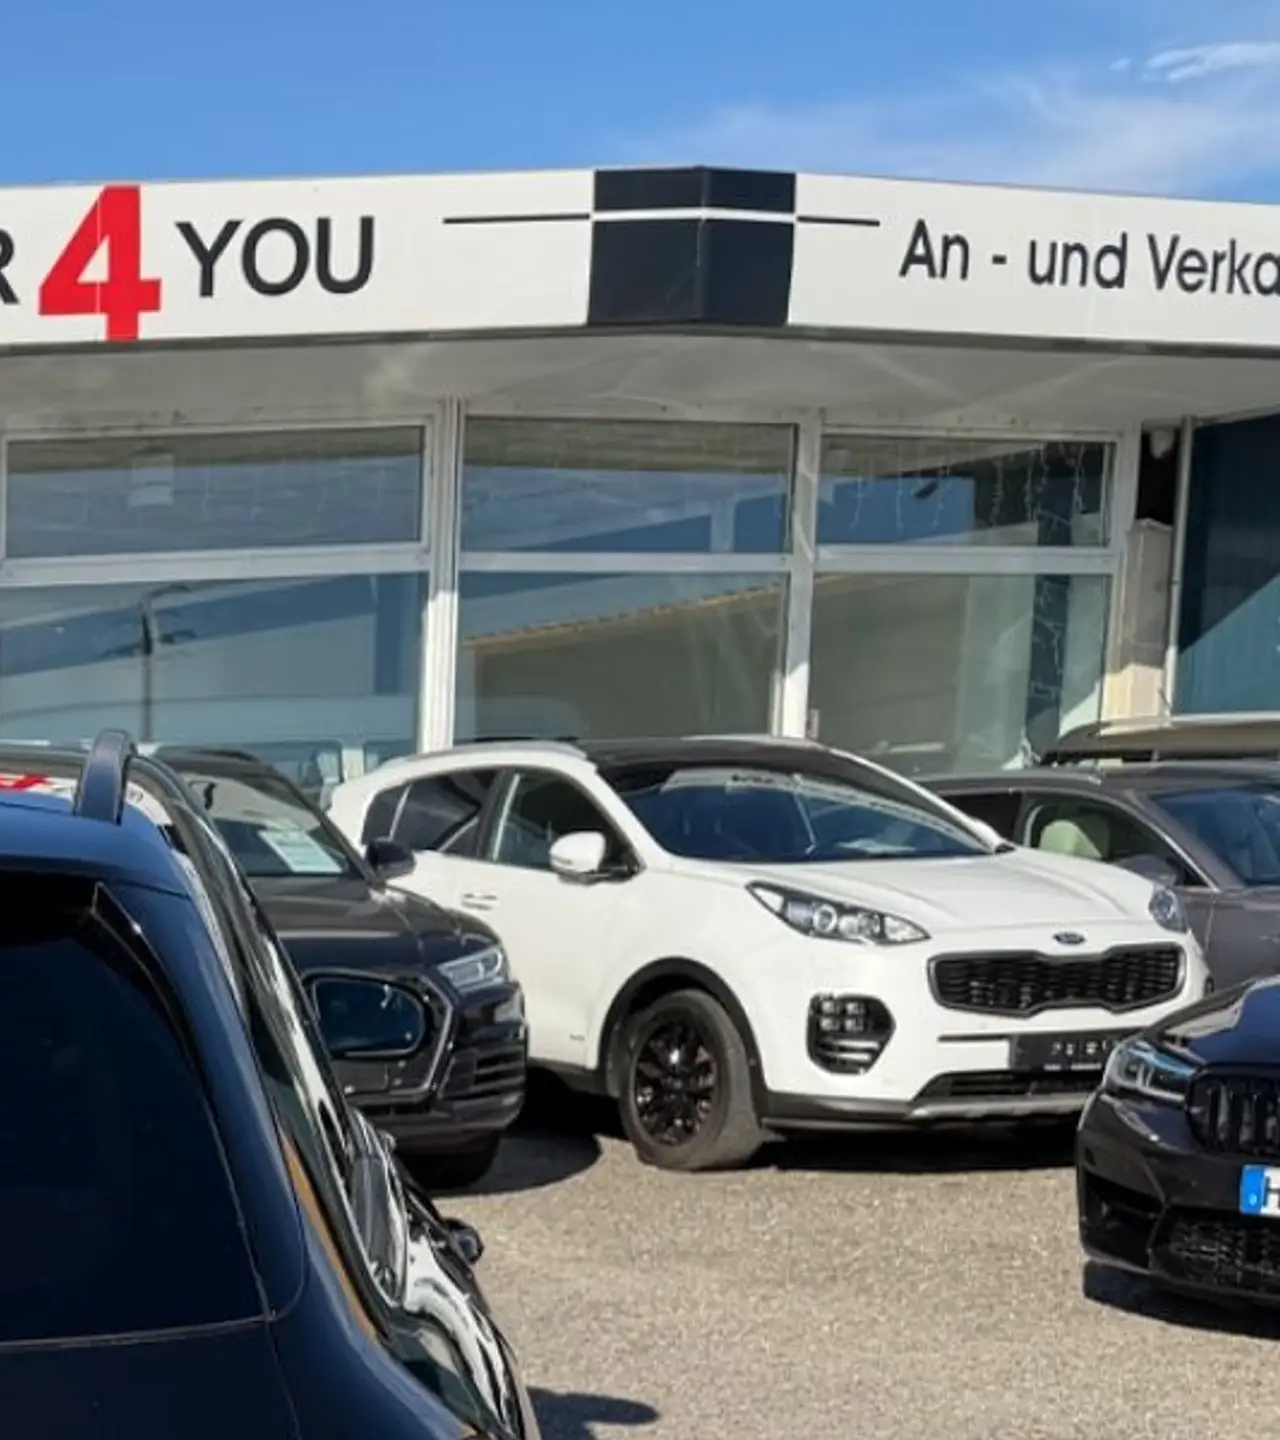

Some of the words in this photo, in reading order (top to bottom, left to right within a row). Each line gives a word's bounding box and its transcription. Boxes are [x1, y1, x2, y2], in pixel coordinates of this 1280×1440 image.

[38, 184, 162, 341] 4
[176, 216, 375, 298] YOU
[899, 219, 970, 279] An
[1028, 232, 1128, 289] und
